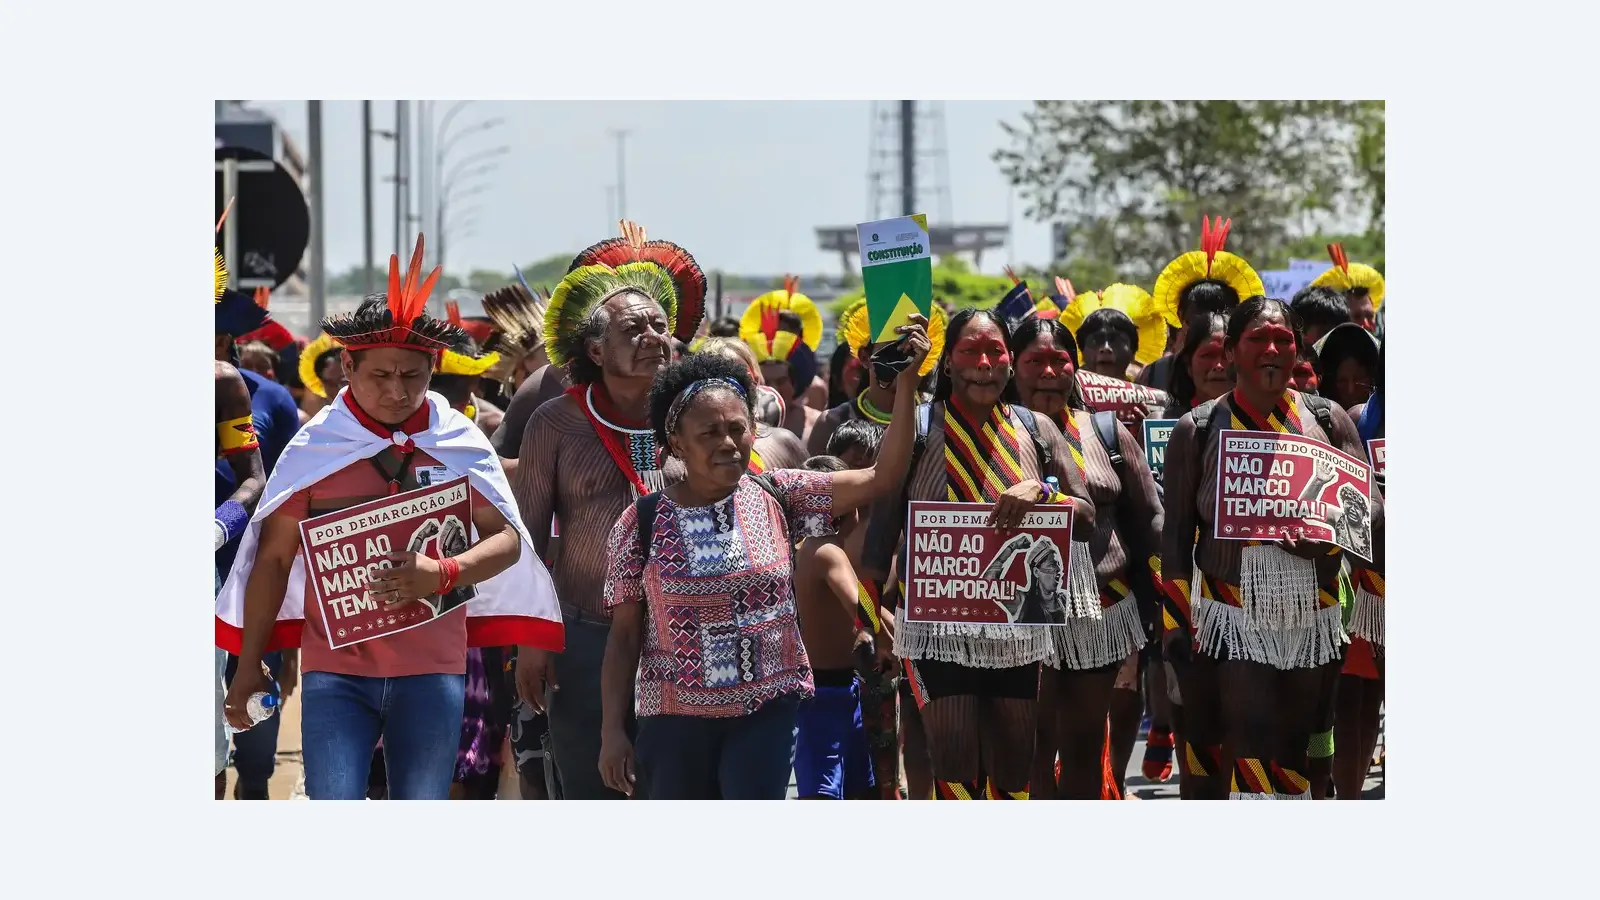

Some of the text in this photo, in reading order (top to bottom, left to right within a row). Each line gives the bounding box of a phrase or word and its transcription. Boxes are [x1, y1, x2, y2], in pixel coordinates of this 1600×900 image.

[867, 242, 923, 262] CONSTITUIÇÃO
[1080, 371, 1124, 387] MARCO
[1084, 387, 1157, 404] TEMPORAL!
[1225, 454, 1294, 477] NÃO AO
[1228, 440, 1365, 479] PELO FIM DO GENOCÍDIO
[1224, 477, 1290, 497] MARCO
[315, 487, 463, 541] POR DEMARCAÇÃO JÁ
[1223, 497, 1327, 520] TEMPORAL!
[920, 514, 1063, 527] POR DEMAÇÃO JÁ
[914, 529, 984, 554] NÃO AO
[315, 534, 392, 573] NÃO AO
[914, 556, 980, 577] MARCO
[913, 578, 1016, 600] TEMPORAL!
